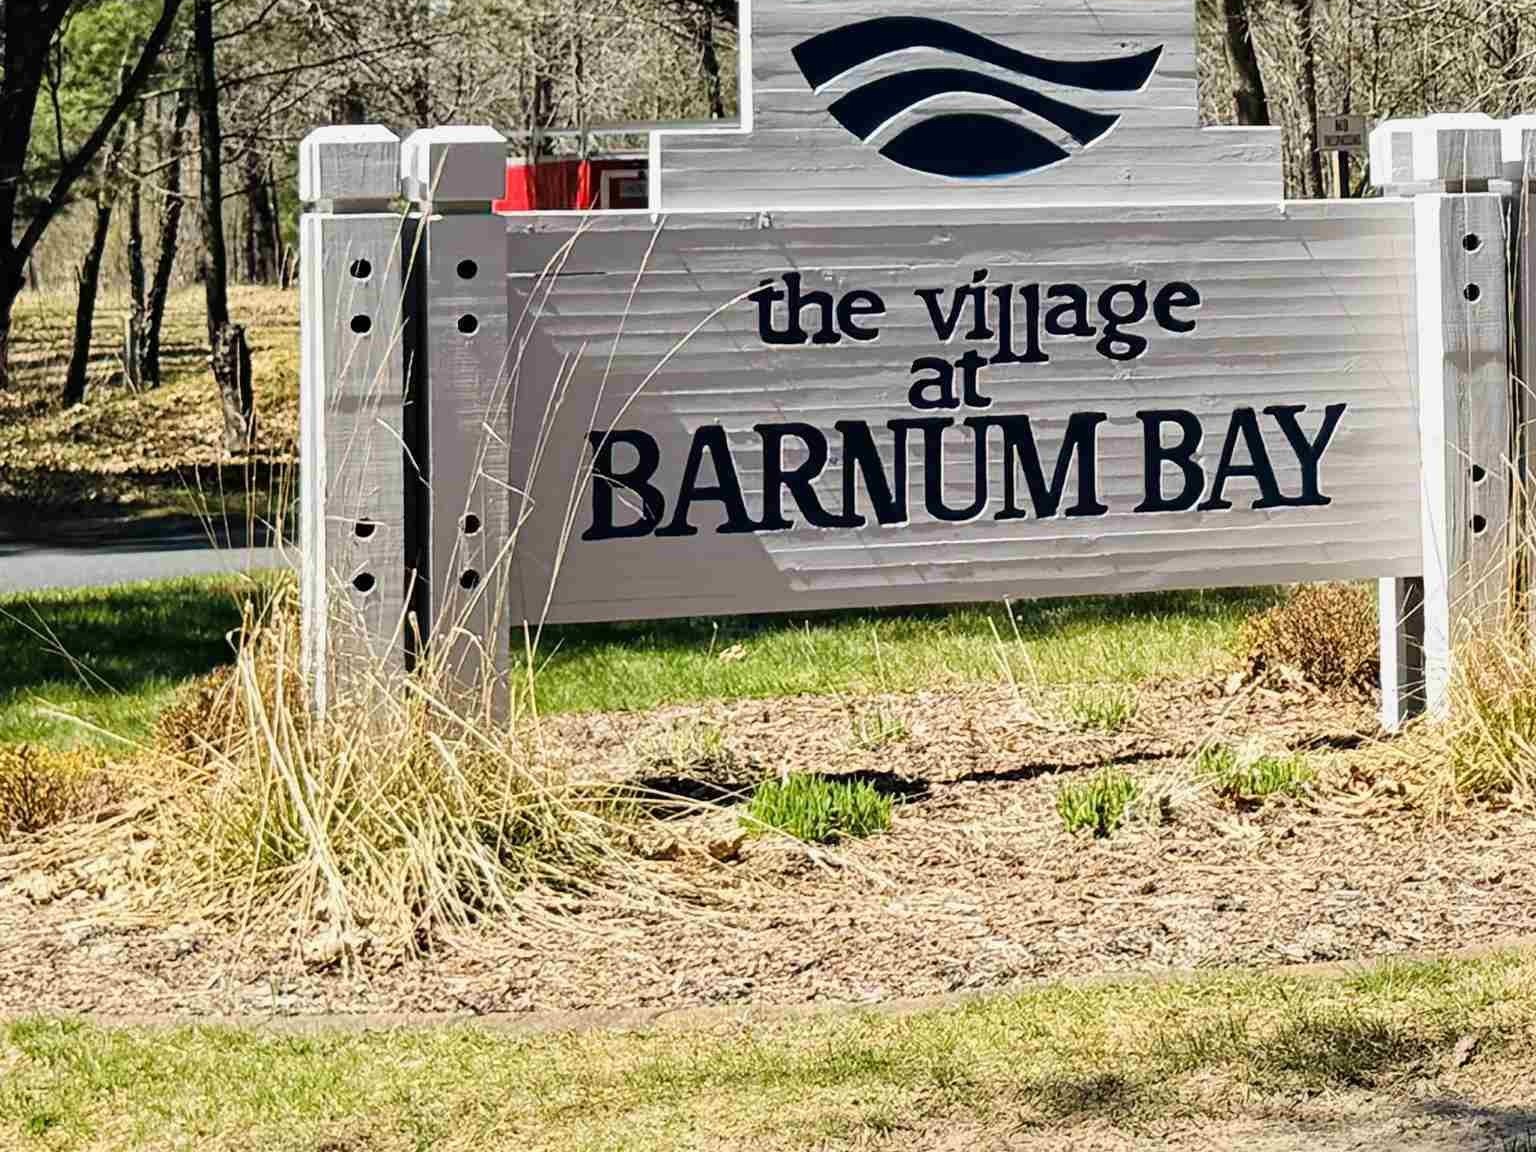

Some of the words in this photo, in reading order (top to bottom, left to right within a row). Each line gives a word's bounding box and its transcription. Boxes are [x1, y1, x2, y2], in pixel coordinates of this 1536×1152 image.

[747, 271, 886, 345] the
[914, 268, 1200, 365] village
[908, 349, 992, 410] at
[581, 411, 1109, 542] BARNUM
[1133, 403, 1346, 513] BAY
